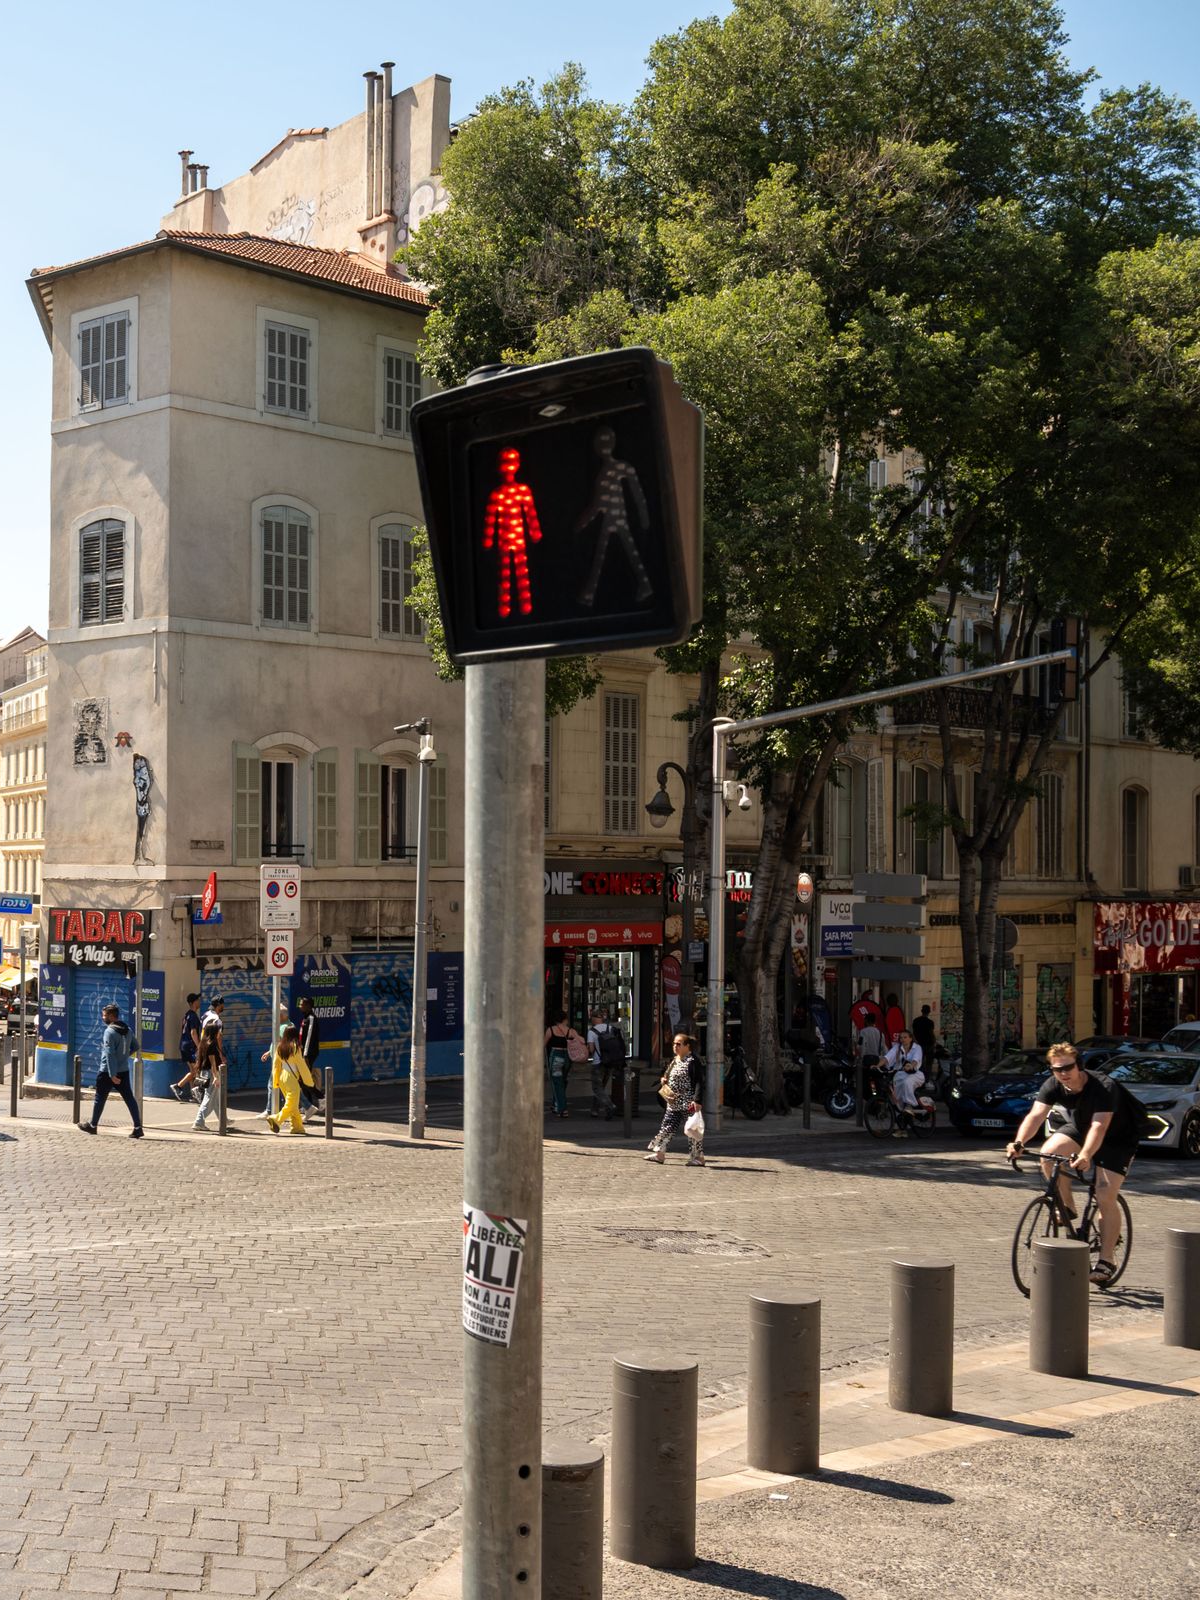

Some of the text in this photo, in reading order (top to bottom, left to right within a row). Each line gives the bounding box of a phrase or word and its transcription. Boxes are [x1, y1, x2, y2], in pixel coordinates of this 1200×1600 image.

[2, 899, 18, 907] FDJ
[50, 909, 145, 945] TABAC
[68, 944, 116, 966] Le Naja
[275, 953, 286, 963] 30
[310, 969, 338, 977] PARIONS
[471, 1223, 522, 1249] LIBÉREZ
[466, 1239, 520, 1289] ALI
[495, 1295, 511, 1310] LA
